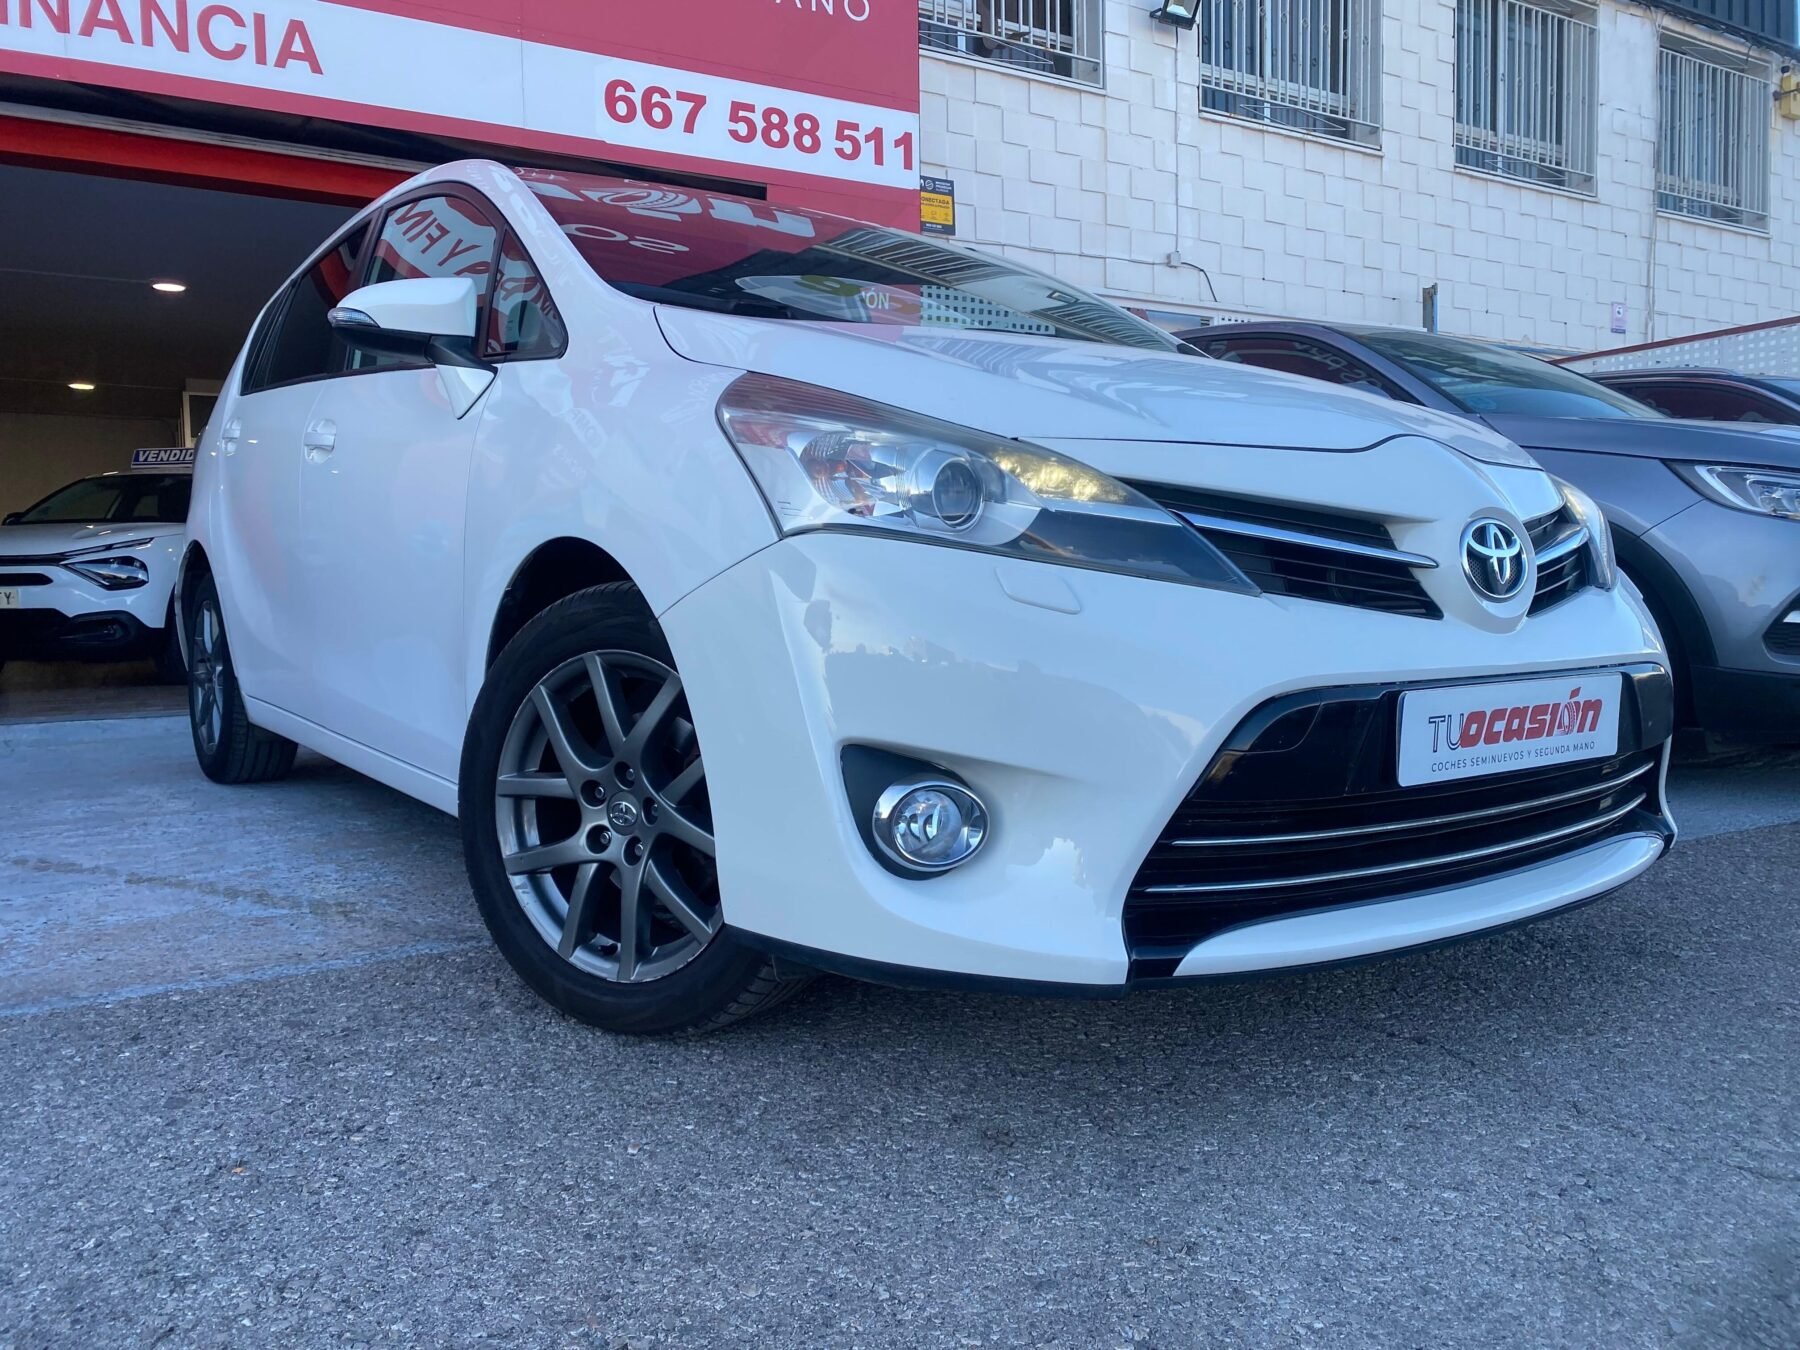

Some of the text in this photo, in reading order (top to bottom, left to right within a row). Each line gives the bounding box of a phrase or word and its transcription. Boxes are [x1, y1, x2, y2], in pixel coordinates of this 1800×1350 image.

[603, 79, 914, 171] 667 588 511
[1431, 741, 1596, 773] COCHES SEMINUEVOS Y SEGUNDA MANO
